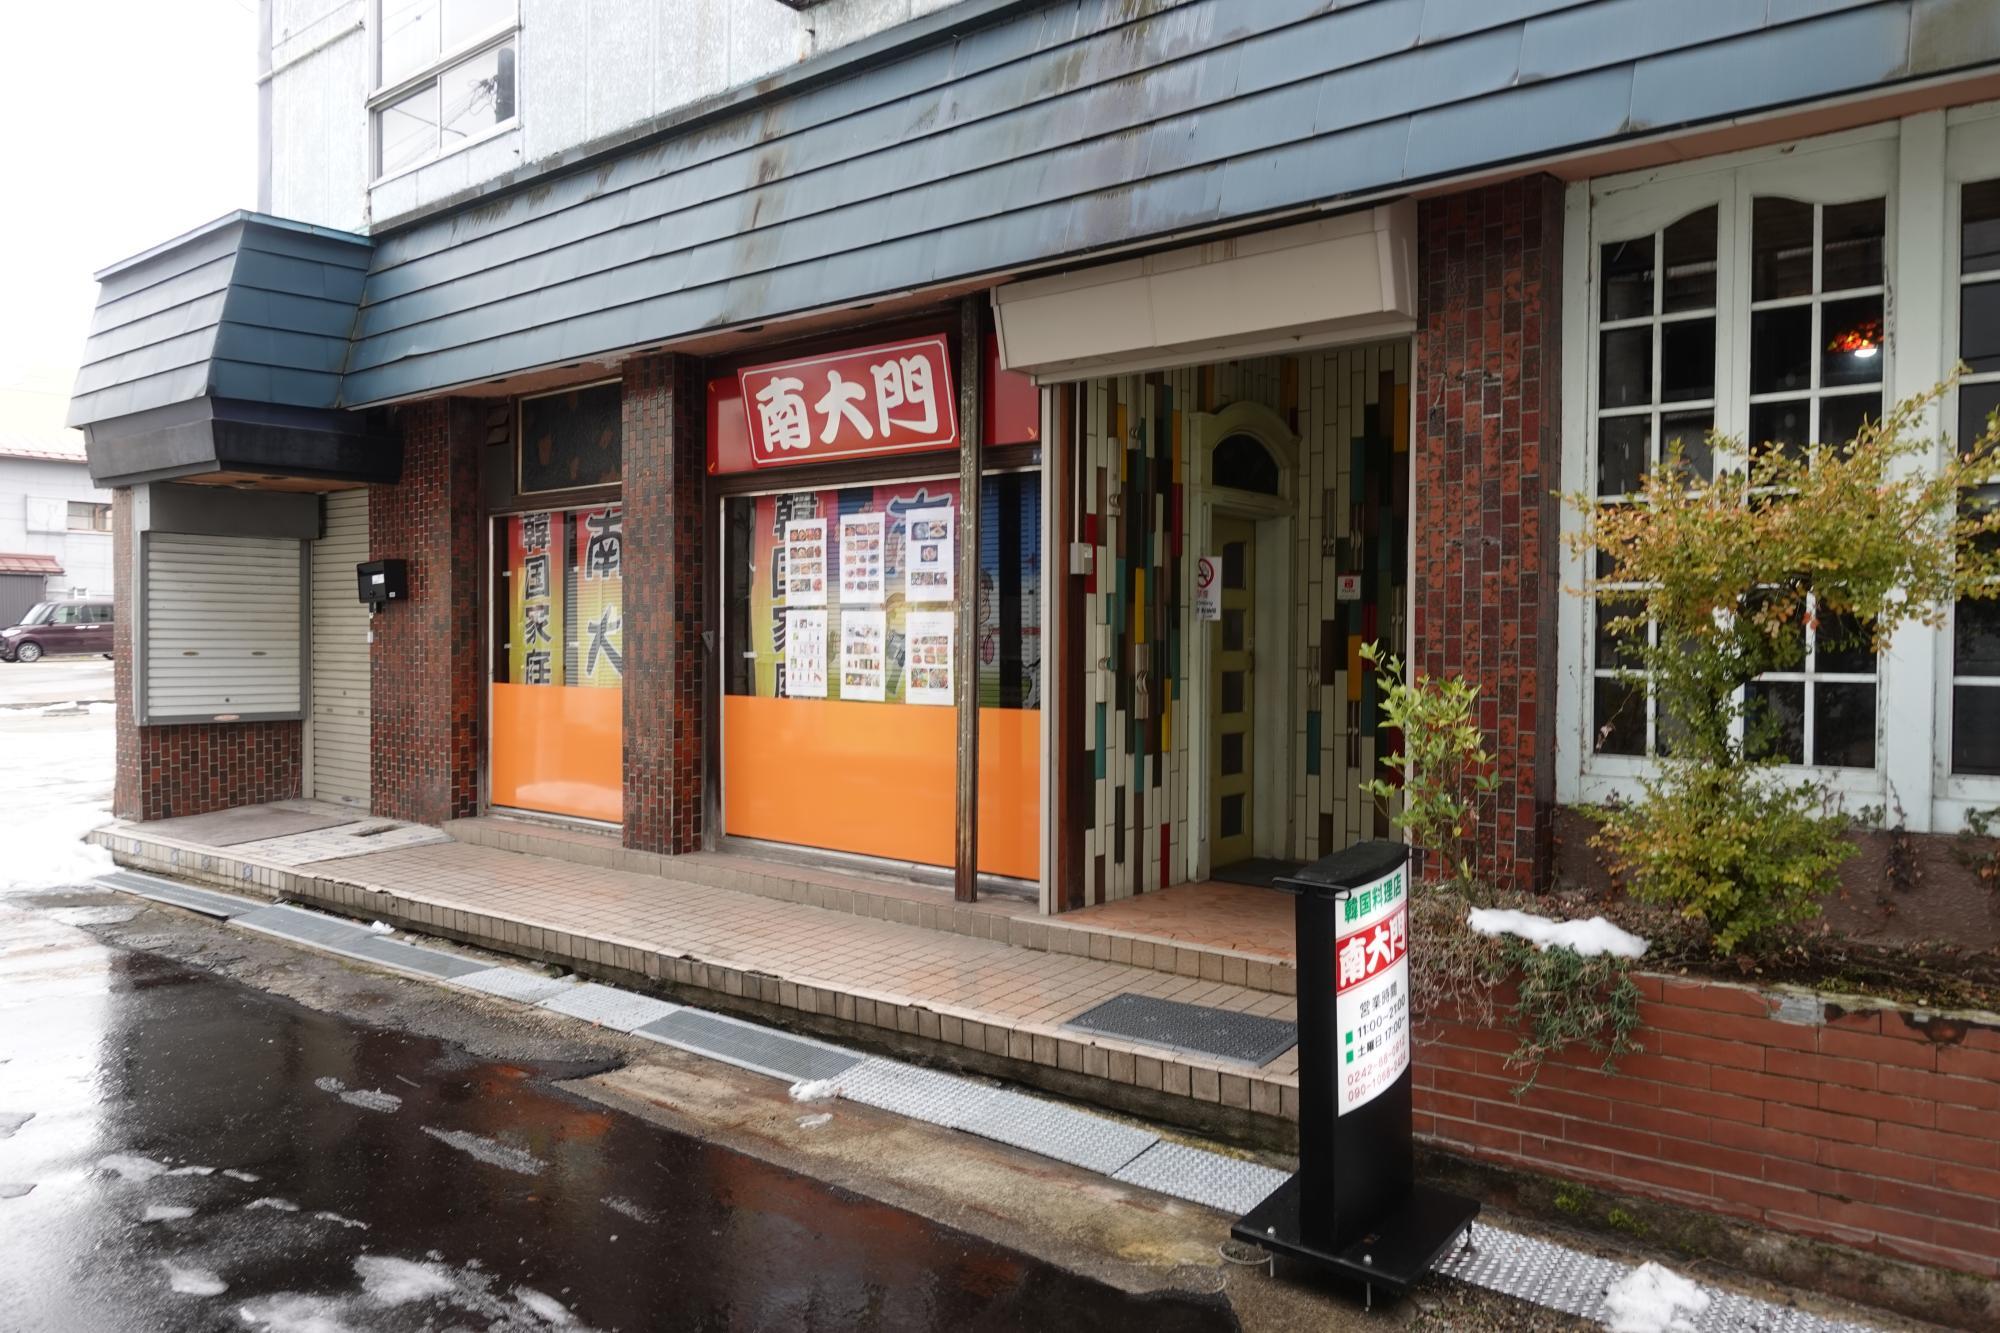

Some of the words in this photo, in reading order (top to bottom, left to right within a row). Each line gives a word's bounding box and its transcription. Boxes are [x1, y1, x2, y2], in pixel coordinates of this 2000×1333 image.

[755, 354, 939, 454] 南大門
[519, 511, 552, 686] 韓国家庭
[1344, 873, 1402, 923] 韓国料理店
[1339, 912, 1406, 988] 南大門
[1359, 981, 1398, 1018] 営業時間
[1357, 1034, 1383, 1059] 土曜日
